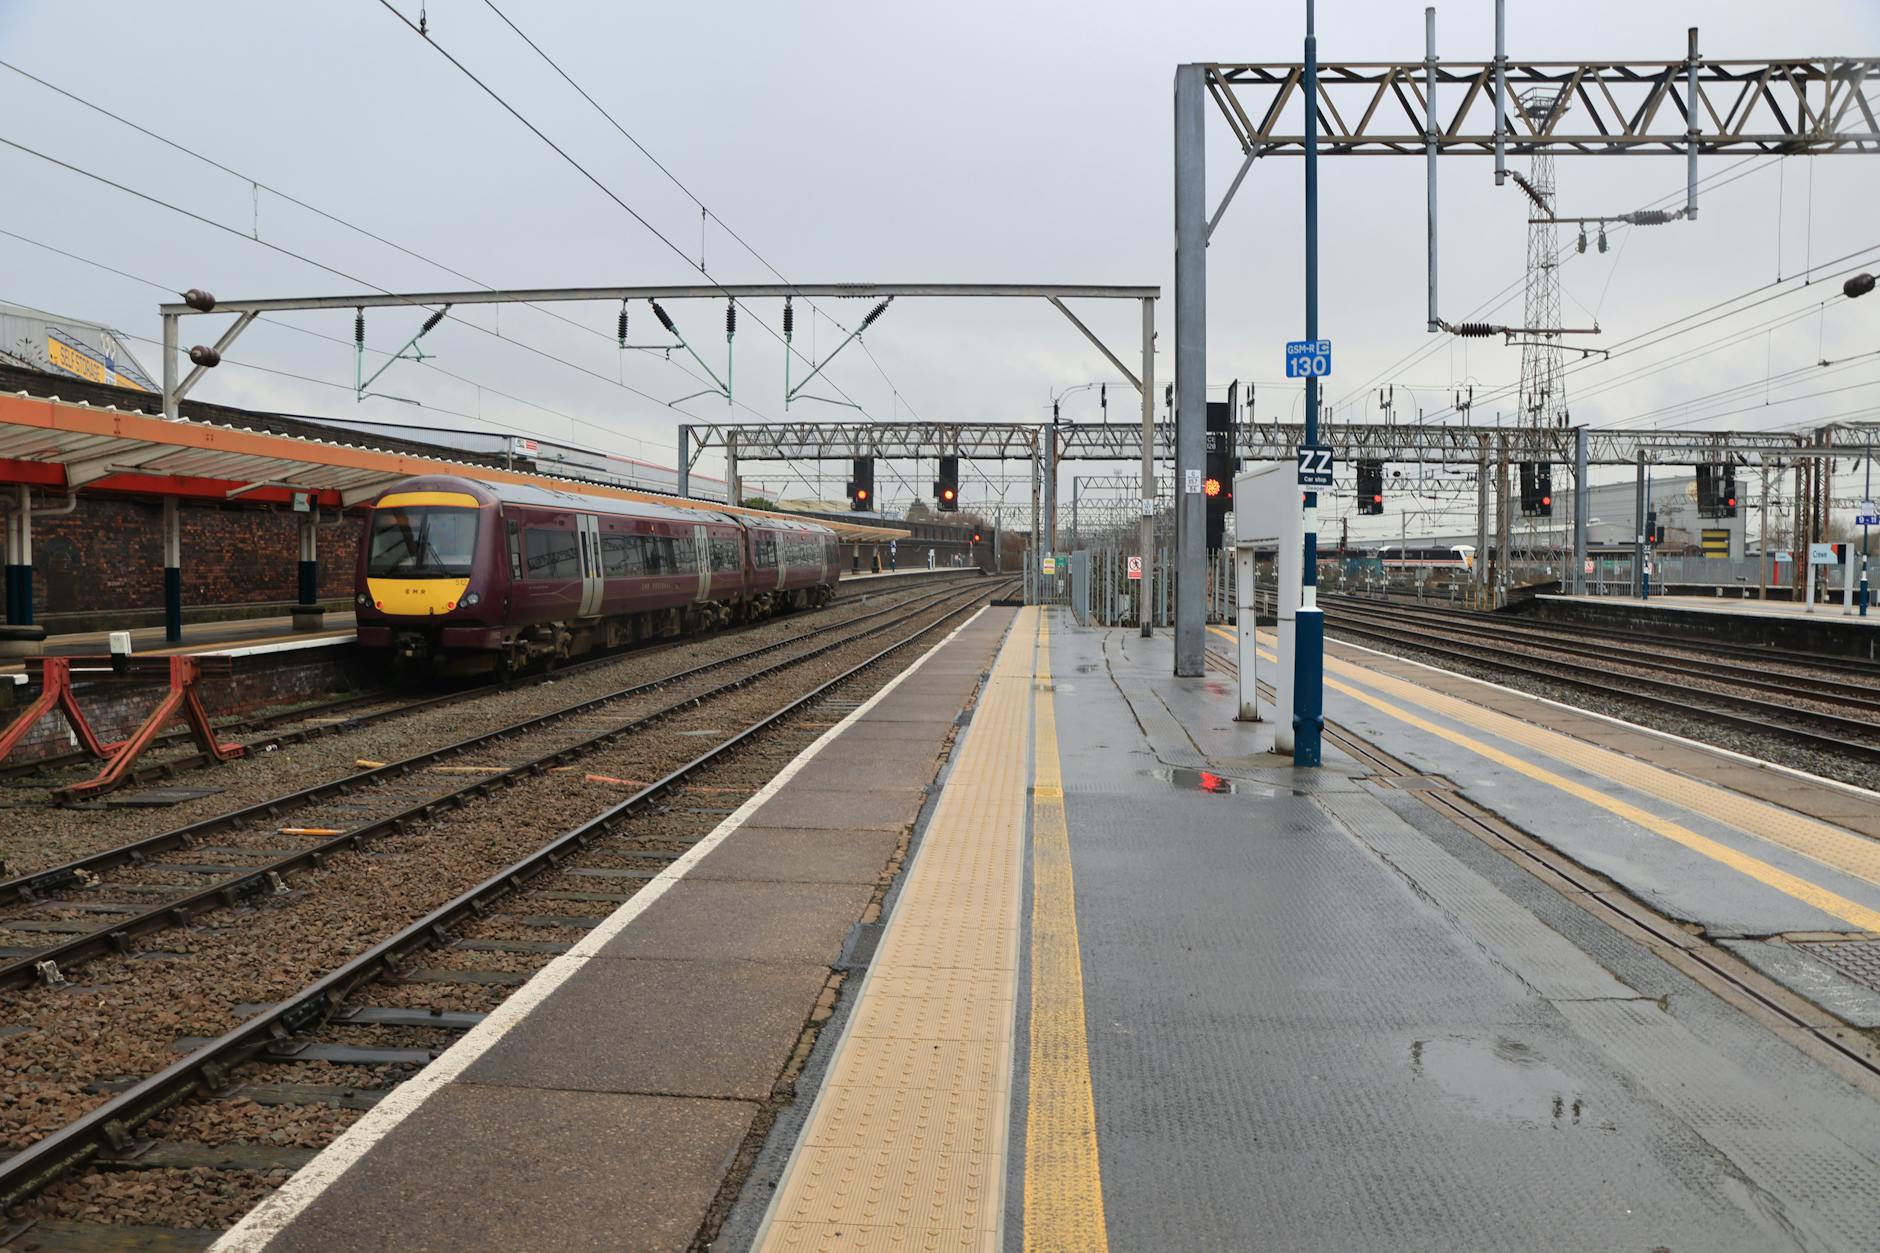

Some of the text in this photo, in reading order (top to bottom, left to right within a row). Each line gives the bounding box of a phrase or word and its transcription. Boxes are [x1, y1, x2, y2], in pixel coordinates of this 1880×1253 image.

[1287, 344, 1315, 354] GSM-R
[1290, 355, 1327, 376] 130
[1299, 450, 1331, 474] ZZ
[1813, 550, 1827, 558] Crewe
